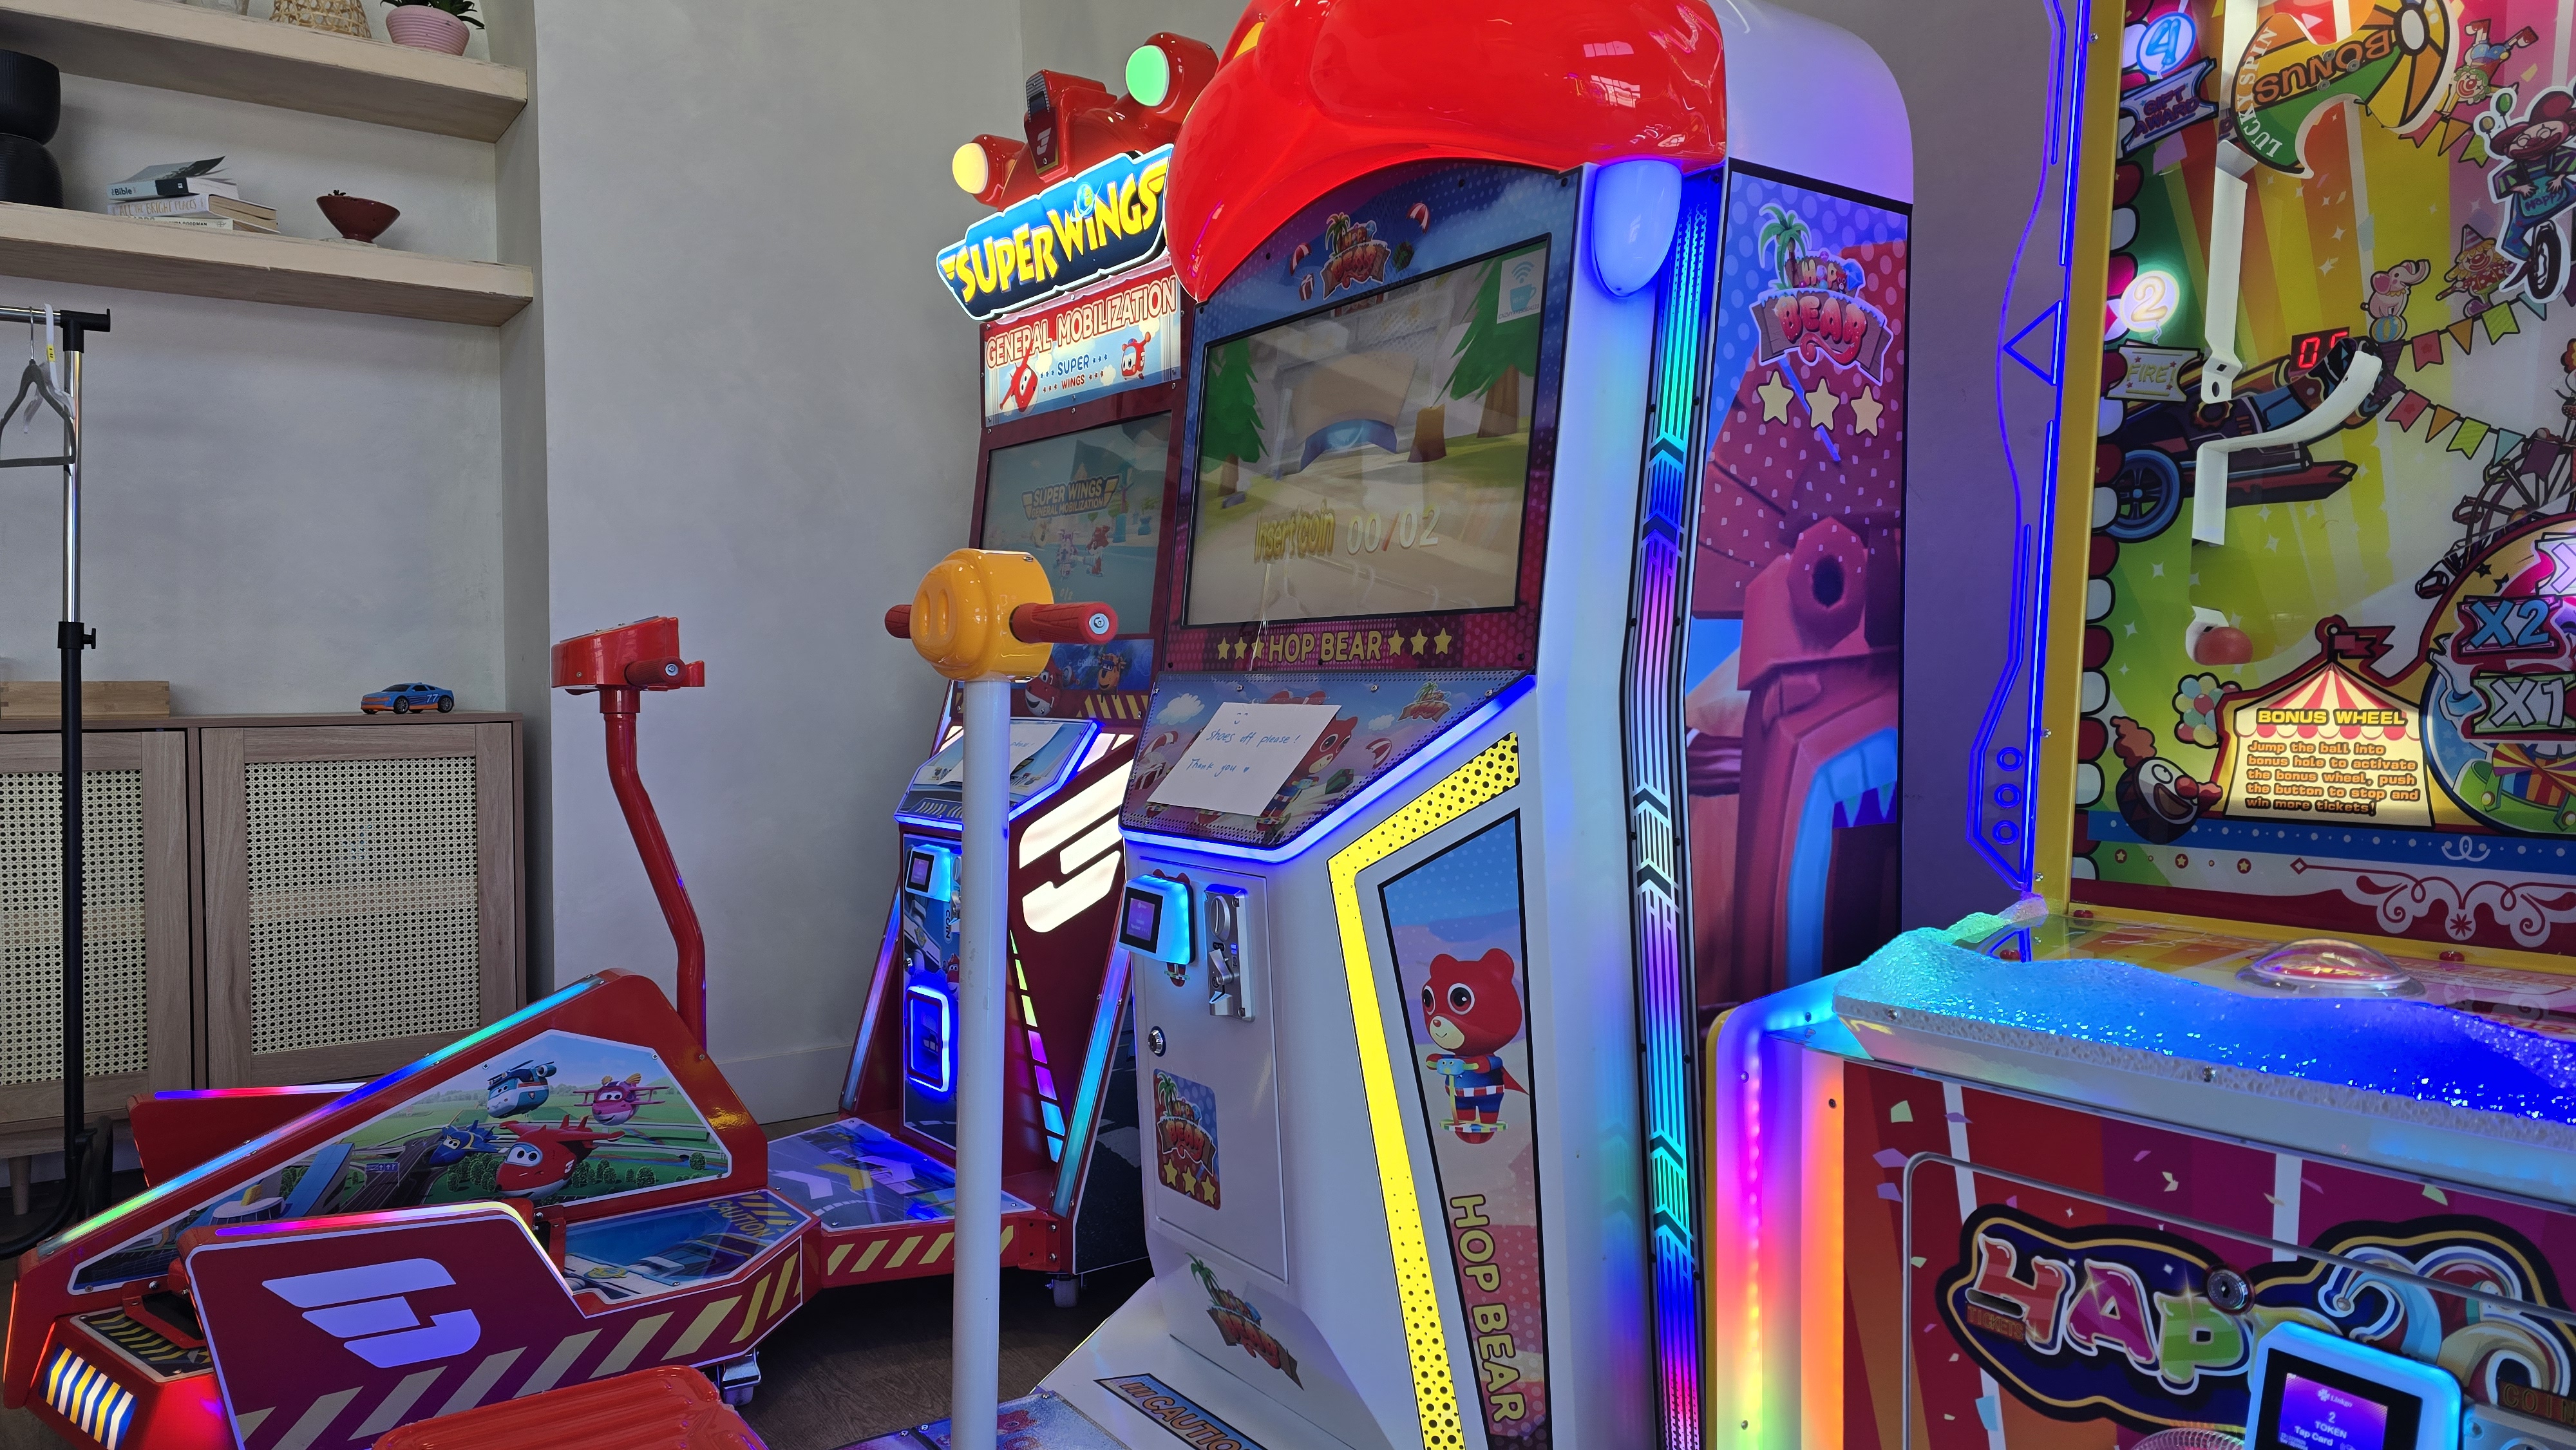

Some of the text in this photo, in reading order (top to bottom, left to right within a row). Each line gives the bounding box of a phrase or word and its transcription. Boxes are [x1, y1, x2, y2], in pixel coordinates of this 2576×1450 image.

[2145, 17, 2181, 66] 4
[2254, 29, 2392, 105] BONUS
[2143, 84, 2186, 117] GIFT
[2237, 26, 2283, 158] LUCKY SPIN
[2134, 96, 2201, 138] AWARD
[114, 187, 133, 196] Bible
[146, 200, 172, 214] BRIGHT
[175, 200, 196, 211] PLACES
[940, 157, 1170, 303] SUPER WINGS
[2130, 275, 2168, 323] 2
[986, 276, 1177, 368] GENERAL MOBILIZATION
[1774, 295, 1868, 364] BEAR
[1057, 353, 1090, 375] SUPER
[2126, 363, 2177, 385] FIRE!
[1061, 373, 1086, 390] WINGS
[1031, 496, 1104, 518] GENERAL MOBILIZATION
[1033, 478, 1103, 507] SUPER WINGS
[1253, 505, 1298, 563] Insert
[2469, 598, 2550, 649] X2
[1268, 630, 1383, 664] HOP BEAR
[426, 693, 439, 703] 77
[2489, 676, 2565, 729] X1
[2257, 710, 2407, 726] BONUS WHEEL
[1239, 731, 1258, 746] off
[2249, 741, 2385, 755] Jump the ball into
[1186, 758, 1237, 778] Thank you
[2248, 755, 2416, 771] bonus hole to activate
[2248, 769, 2416, 786] the bonus wheel, push
[2246, 797, 2376, 816] win more tickets!
[2247, 784, 2419, 801] the button to stop and
[1166, 1120, 1206, 1161] BEAR
[708, 1200, 776, 1238] CAUTION
[1450, 1194, 1501, 1293] HOP
[1967, 1304, 2024, 1340] TICKETS
[1471, 1302, 1527, 1424] BEAR
[2330, 1395, 2353, 1408] Linkgo
[1142, 1395, 1245, 1450] CAUTIO
[2314, 1420, 2348, 1439] TOKEN
[2327, 1411, 2336, 1424] 2
[2294, 1425, 2311, 1439] Tap
[2311, 1431, 2334, 1447] Card
